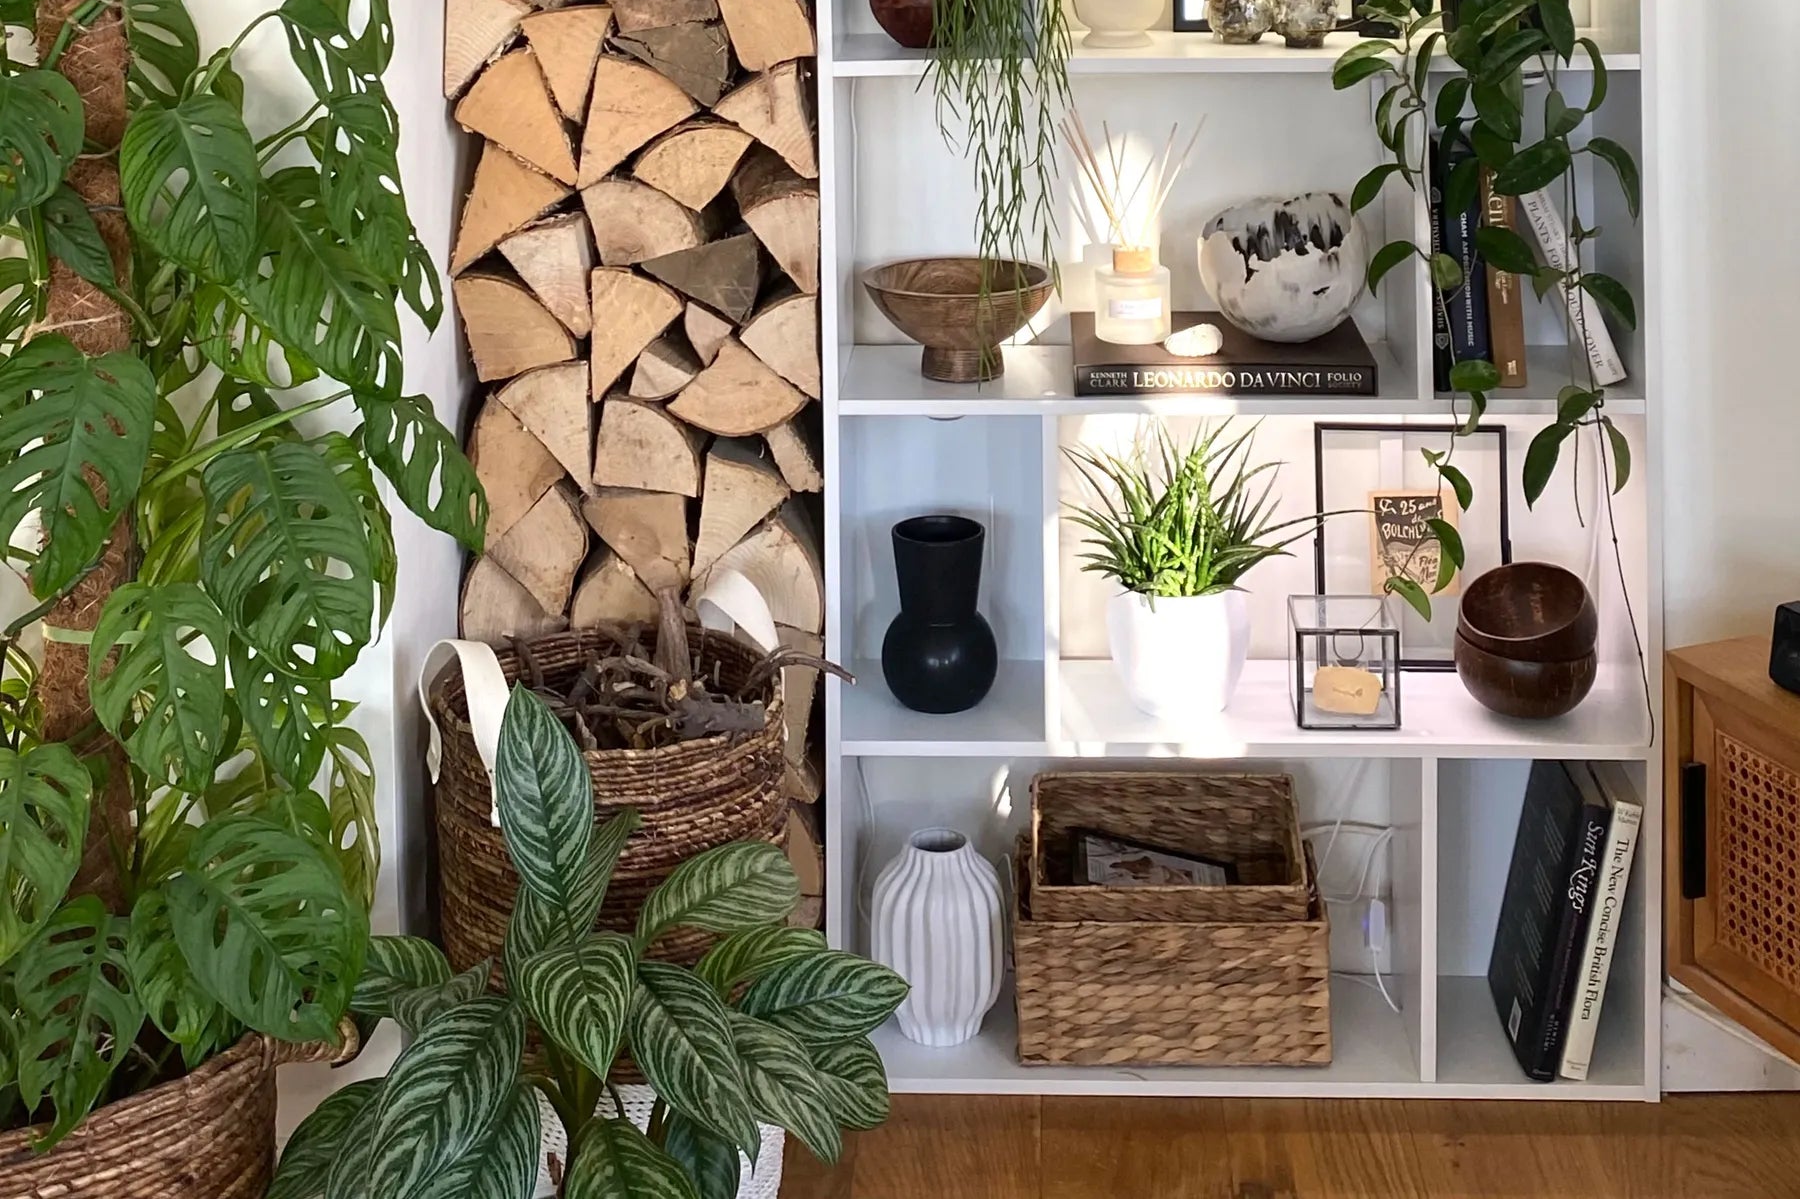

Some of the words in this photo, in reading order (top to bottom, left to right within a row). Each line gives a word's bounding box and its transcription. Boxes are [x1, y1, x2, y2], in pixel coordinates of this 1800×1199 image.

[1528, 200, 1551, 244] PLANTS
[1466, 320, 1474, 346] MUSIC
[1090, 379, 1128, 388] CLARK
[1133, 371, 1236, 388] LEONARDO
[1240, 372, 1264, 388] DA
[1267, 372, 1321, 388] VINCI
[1327, 372, 1362, 382] FOLIO
[1400, 500, 1416, 516] 25
[1584, 821, 1605, 854] Sun
[1613, 838, 1629, 863] The
[1568, 857, 1597, 913] Kings
[1607, 866, 1623, 893] New
[1596, 895, 1617, 943] Concise
[1588, 946, 1607, 986] British
[1581, 989, 1598, 1020] Flora
